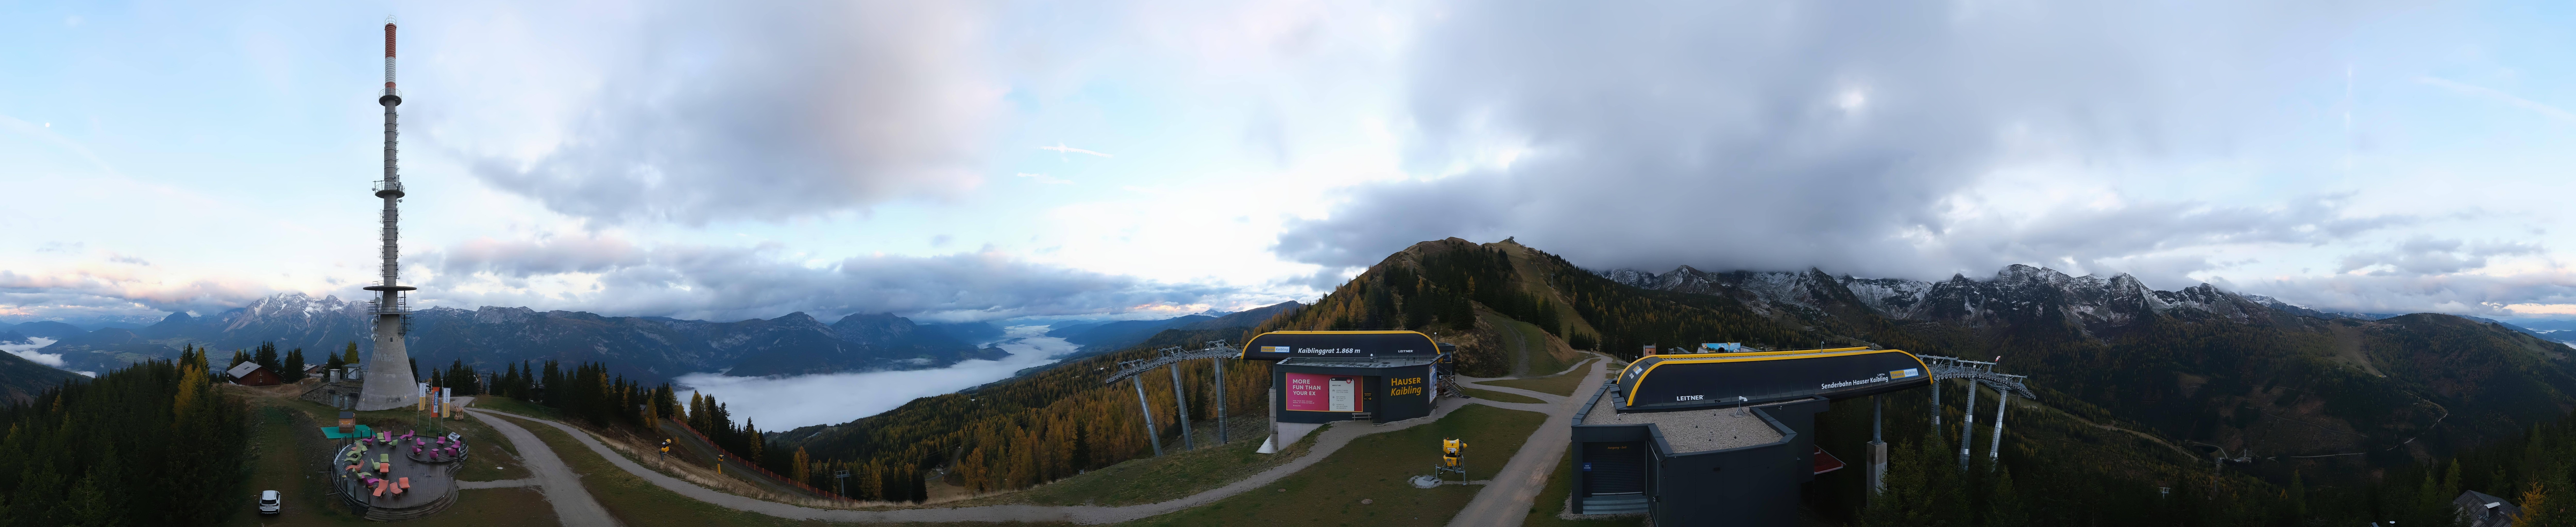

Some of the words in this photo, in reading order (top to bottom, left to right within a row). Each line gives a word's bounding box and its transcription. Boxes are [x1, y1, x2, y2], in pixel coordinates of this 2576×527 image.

[1391, 378, 1421, 386] HAUSER
[1822, 381, 1852, 389] Senderbahn
[1391, 386, 1421, 396] Kaibling
